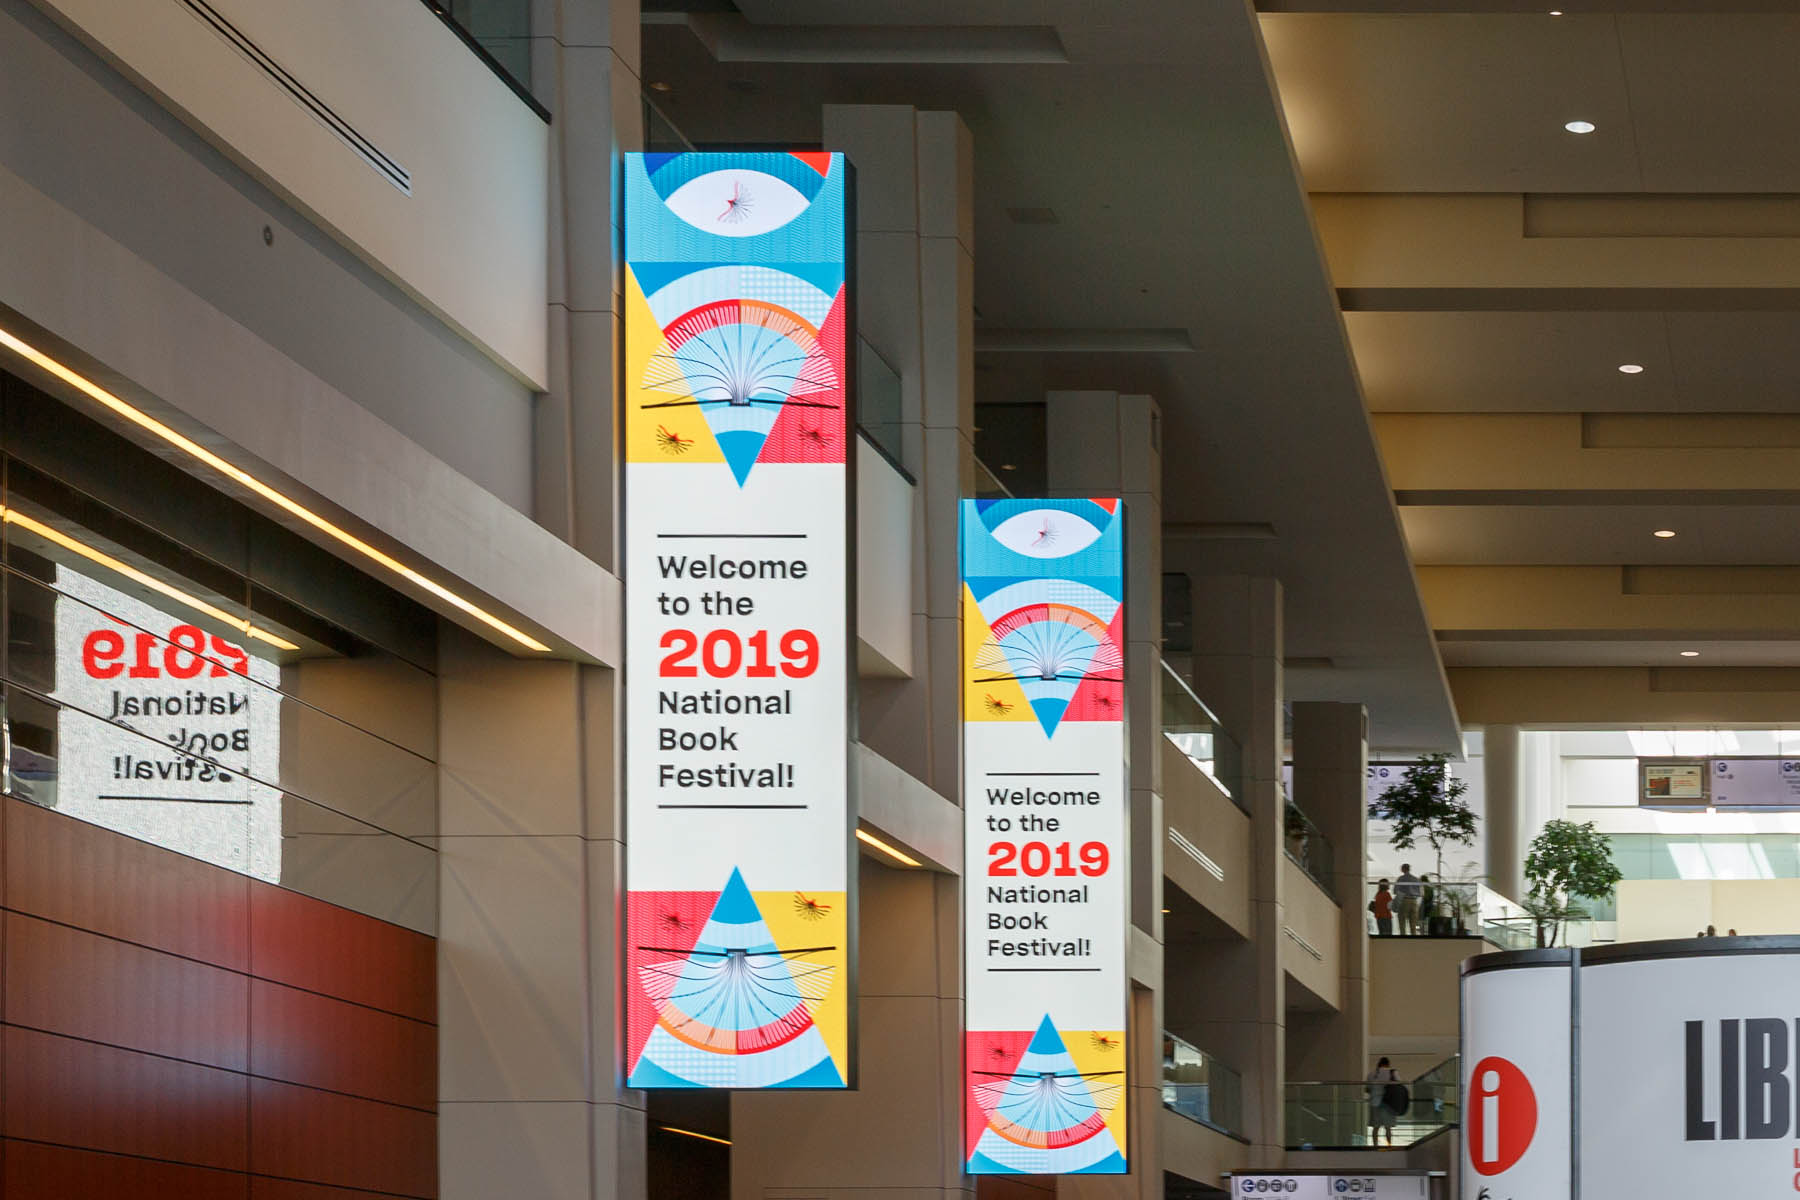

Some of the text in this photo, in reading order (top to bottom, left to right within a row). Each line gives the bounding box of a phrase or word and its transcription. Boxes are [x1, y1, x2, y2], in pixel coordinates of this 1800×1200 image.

[658, 554, 807, 579] Welcome
[658, 591, 753, 615] to the
[659, 629, 819, 678] 2019
[659, 689, 790, 714] National
[659, 726, 738, 751] Book
[659, 763, 793, 788] Festival!
[987, 788, 1100, 805] Welcome
[987, 814, 1059, 832] to the
[988, 841, 1109, 877] 2019
[987, 885, 1087, 903] National
[988, 912, 1048, 929] Book
[988, 938, 1090, 956] Festival!
